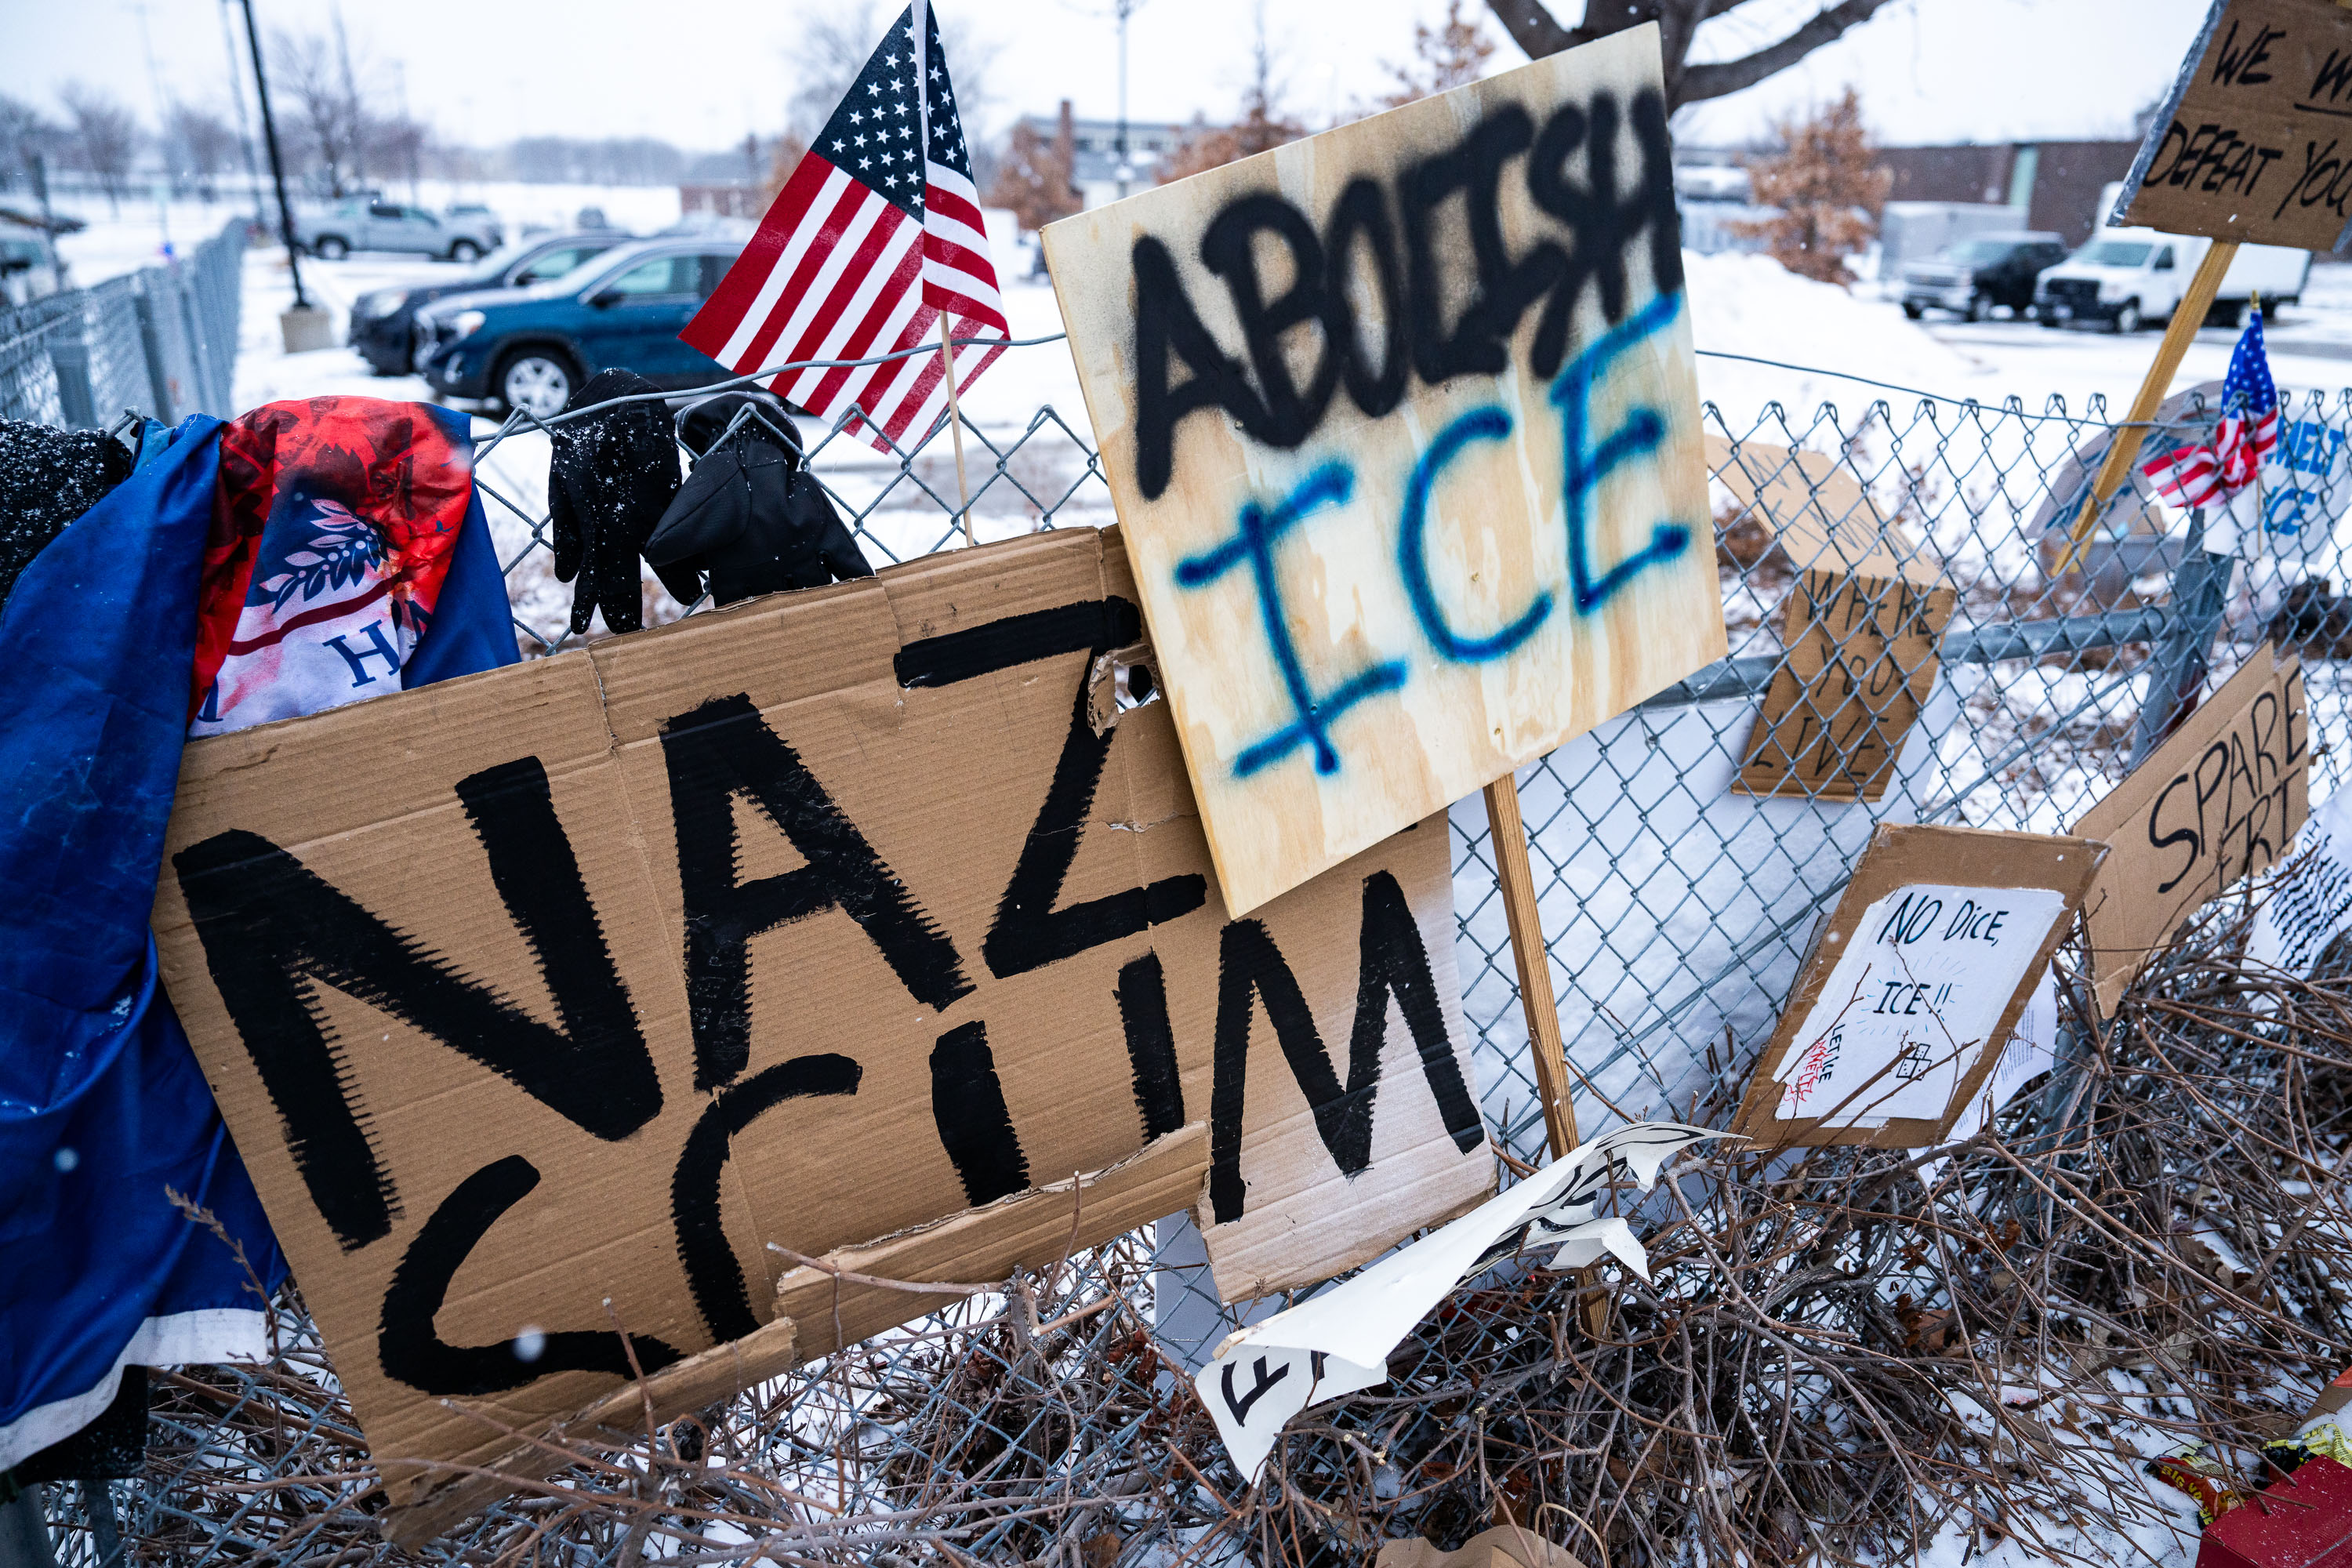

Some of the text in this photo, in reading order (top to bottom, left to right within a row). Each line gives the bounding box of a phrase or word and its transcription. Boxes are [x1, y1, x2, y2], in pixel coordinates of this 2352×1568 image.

[2210, 20, 2352, 103] WE W
[2142, 120, 2284, 196] DEFEAT
[1131, 88, 1684, 502] ABOLISH
[1174, 290, 1691, 780] ICE
[1806, 567, 1941, 640] WHERE
[1816, 643, 1898, 697] YOU
[1752, 711, 1889, 778] LIVE
[2149, 665, 2308, 894] SPARE
[172, 596, 1417, 1255] NAZ
[1877, 892, 1943, 945] NO
[1828, 1023, 1846, 1054] LET
[379, 869, 1486, 1397] SCUM
